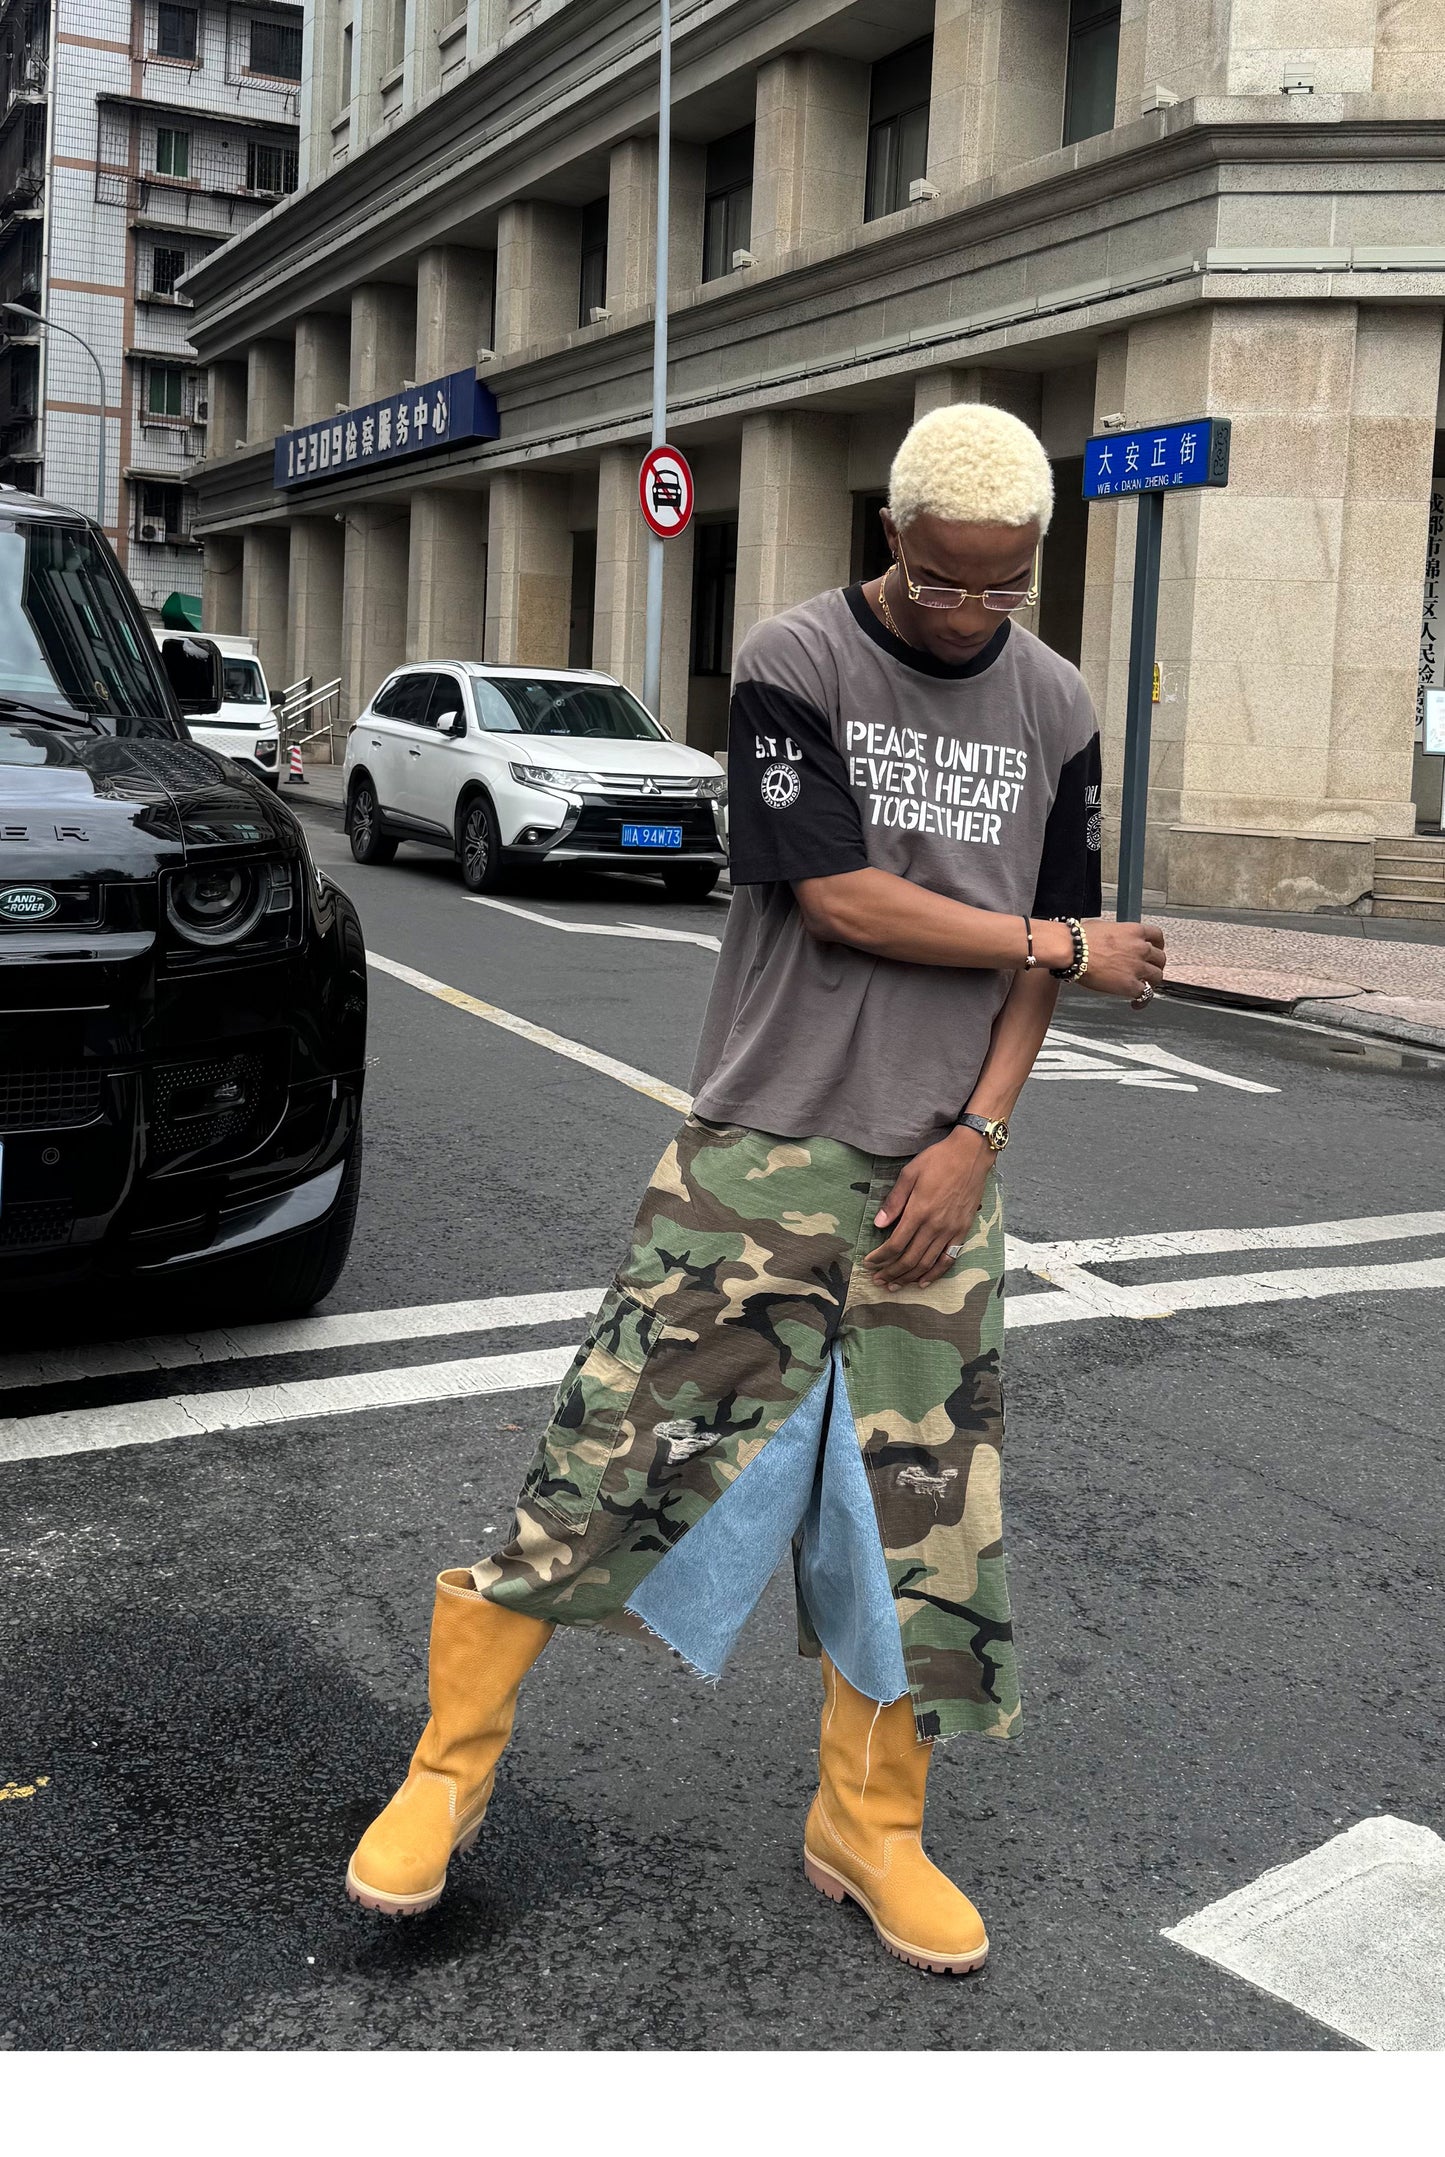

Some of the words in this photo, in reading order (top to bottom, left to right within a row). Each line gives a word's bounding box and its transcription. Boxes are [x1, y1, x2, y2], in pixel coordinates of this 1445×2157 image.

[287, 390, 448, 477] 12309检察服务中心
[1098, 432, 1197, 476] 大安正街
[1144, 474, 1169, 488] ZHENG
[1172, 472, 1184, 484] JIE
[846, 720, 928, 764] PEACE
[934, 736, 1028, 781] UNITES
[849, 756, 929, 797] EVERY
[935, 772, 1024, 814] HEART
[869, 793, 1002, 846] TOGETHER
[10, 903, 45, 912] ROVER
